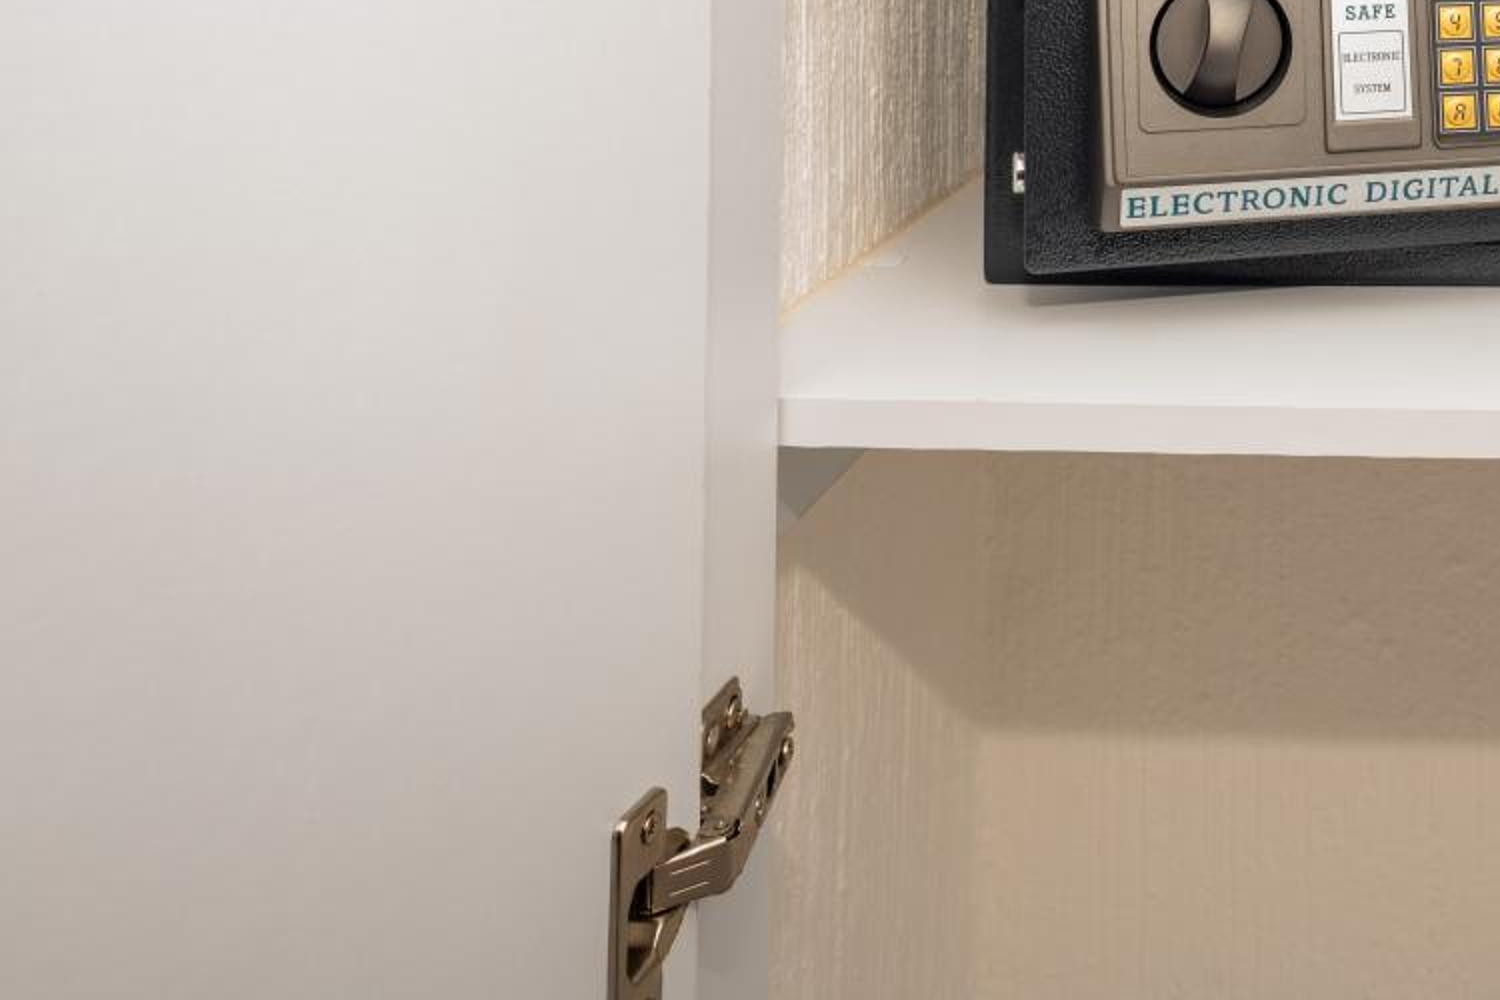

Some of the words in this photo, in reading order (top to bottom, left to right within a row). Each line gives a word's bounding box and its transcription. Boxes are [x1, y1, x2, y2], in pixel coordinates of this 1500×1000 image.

[1345, 4, 1396, 21] SAFE
[1449, 13, 1461, 31] 4
[1344, 51, 1401, 63] ELECTRONIC
[1453, 58, 1462, 76] 7
[1354, 83, 1392, 95] SYSTEM
[1126, 183, 1348, 219] ELECTRONIC
[1365, 173, 1498, 203] DIGITAL
